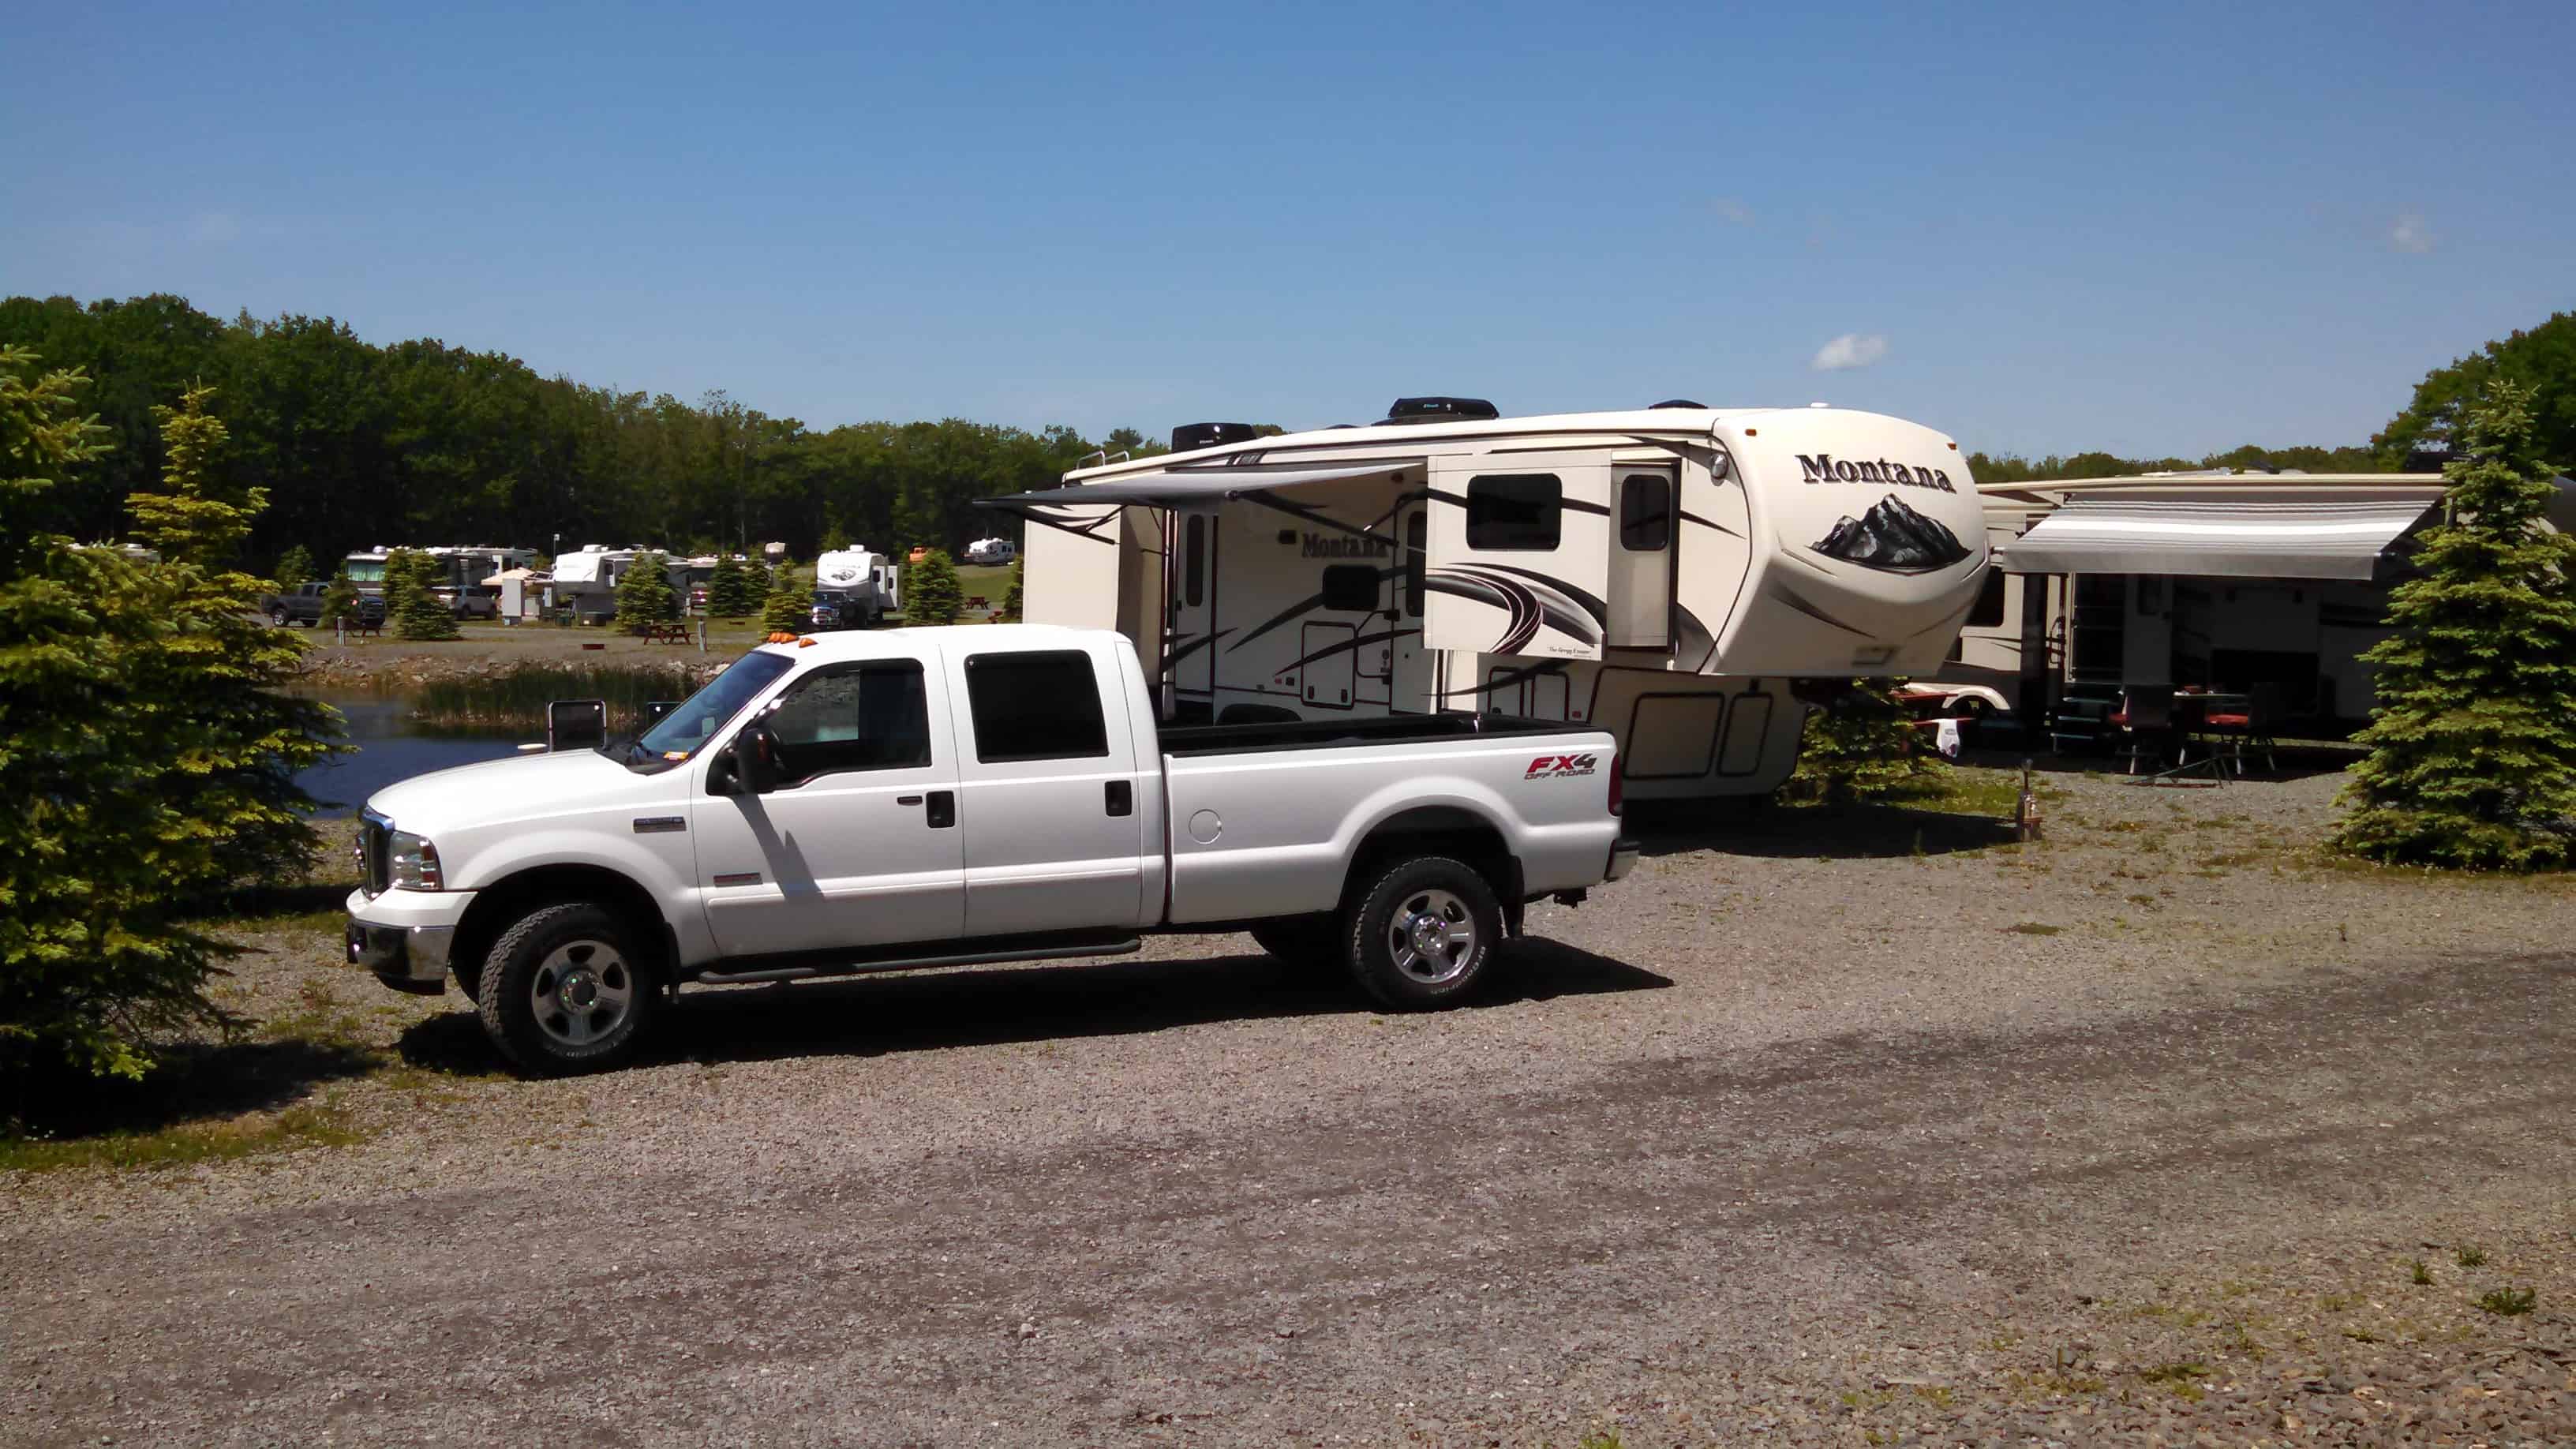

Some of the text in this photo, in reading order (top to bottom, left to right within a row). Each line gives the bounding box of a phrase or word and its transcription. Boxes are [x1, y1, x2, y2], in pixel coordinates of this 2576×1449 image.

[1795, 454, 1956, 494] Montana
[1302, 534, 1388, 558] Montana
[1526, 753, 1597, 773] FX4
